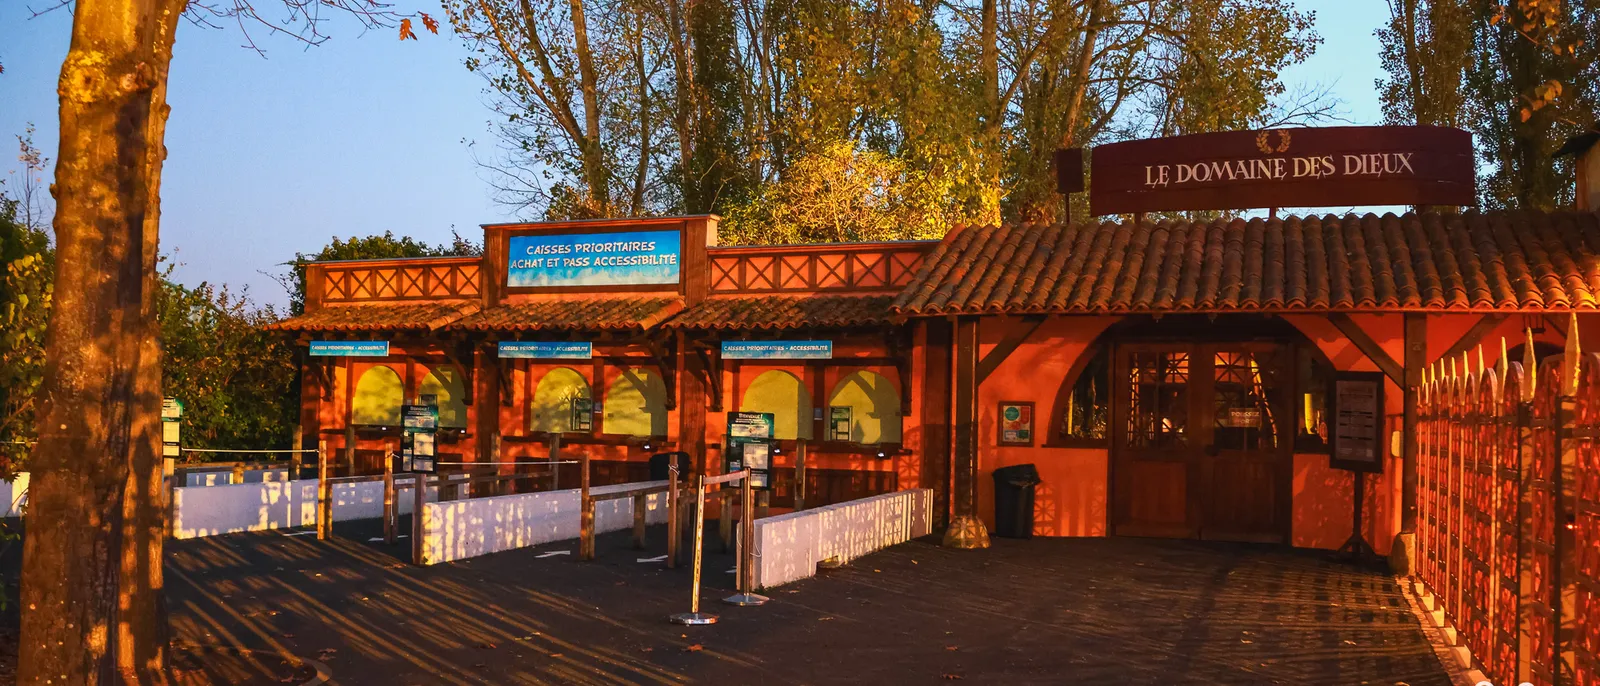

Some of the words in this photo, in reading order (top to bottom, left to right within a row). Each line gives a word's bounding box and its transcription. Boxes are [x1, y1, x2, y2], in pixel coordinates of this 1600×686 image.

[1145, 165, 1171, 189] LE
[1175, 157, 1287, 184] DOMAINE
[1292, 155, 1336, 180] DES
[1343, 152, 1415, 178] DIEUX
[526, 243, 572, 255] CAISSES
[574, 241, 656, 254] PRIORITAIRES
[510, 259, 543, 269] ACHAT
[546, 258, 559, 268] ET
[563, 257, 590, 267] PASS
[593, 254, 677, 267] ACCESSIBILITÉ
